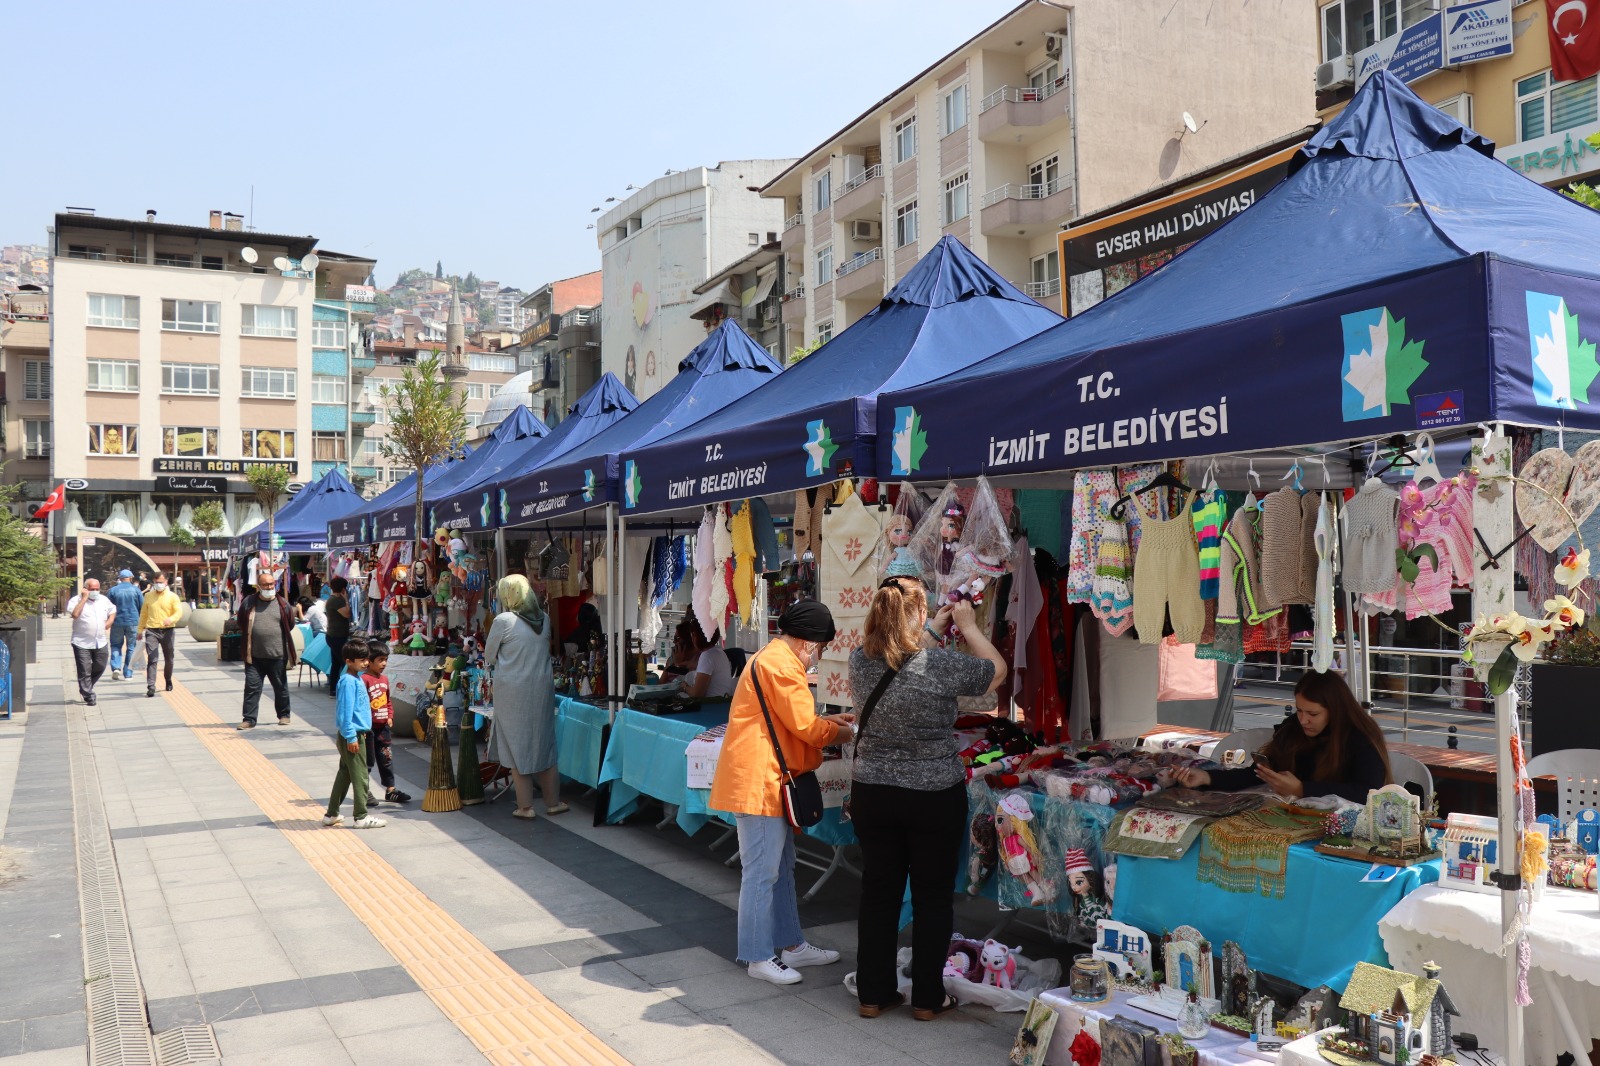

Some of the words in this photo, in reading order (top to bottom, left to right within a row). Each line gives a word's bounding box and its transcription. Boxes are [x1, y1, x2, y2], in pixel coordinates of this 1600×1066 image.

[1462, 14, 1509, 31] AKADEMİ
[1471, 34, 1508, 47] YÖNETİMİ
[1096, 232, 1142, 259] EVSER
[1144, 216, 1179, 243] HALI
[1181, 188, 1255, 232] DÜNYASI
[1077, 371, 1121, 403] T.C.
[1436, 408, 1460, 416] TENT
[988, 429, 1051, 467] İZMİT
[1063, 396, 1229, 455] BELEDİYESİ
[705, 443, 724, 462] T.C.
[159, 460, 202, 471] ZEHRA
[207, 460, 240, 472] AĞDA
[668, 476, 697, 500] İZMİT
[700, 461, 768, 494] BELEDİYESİ
